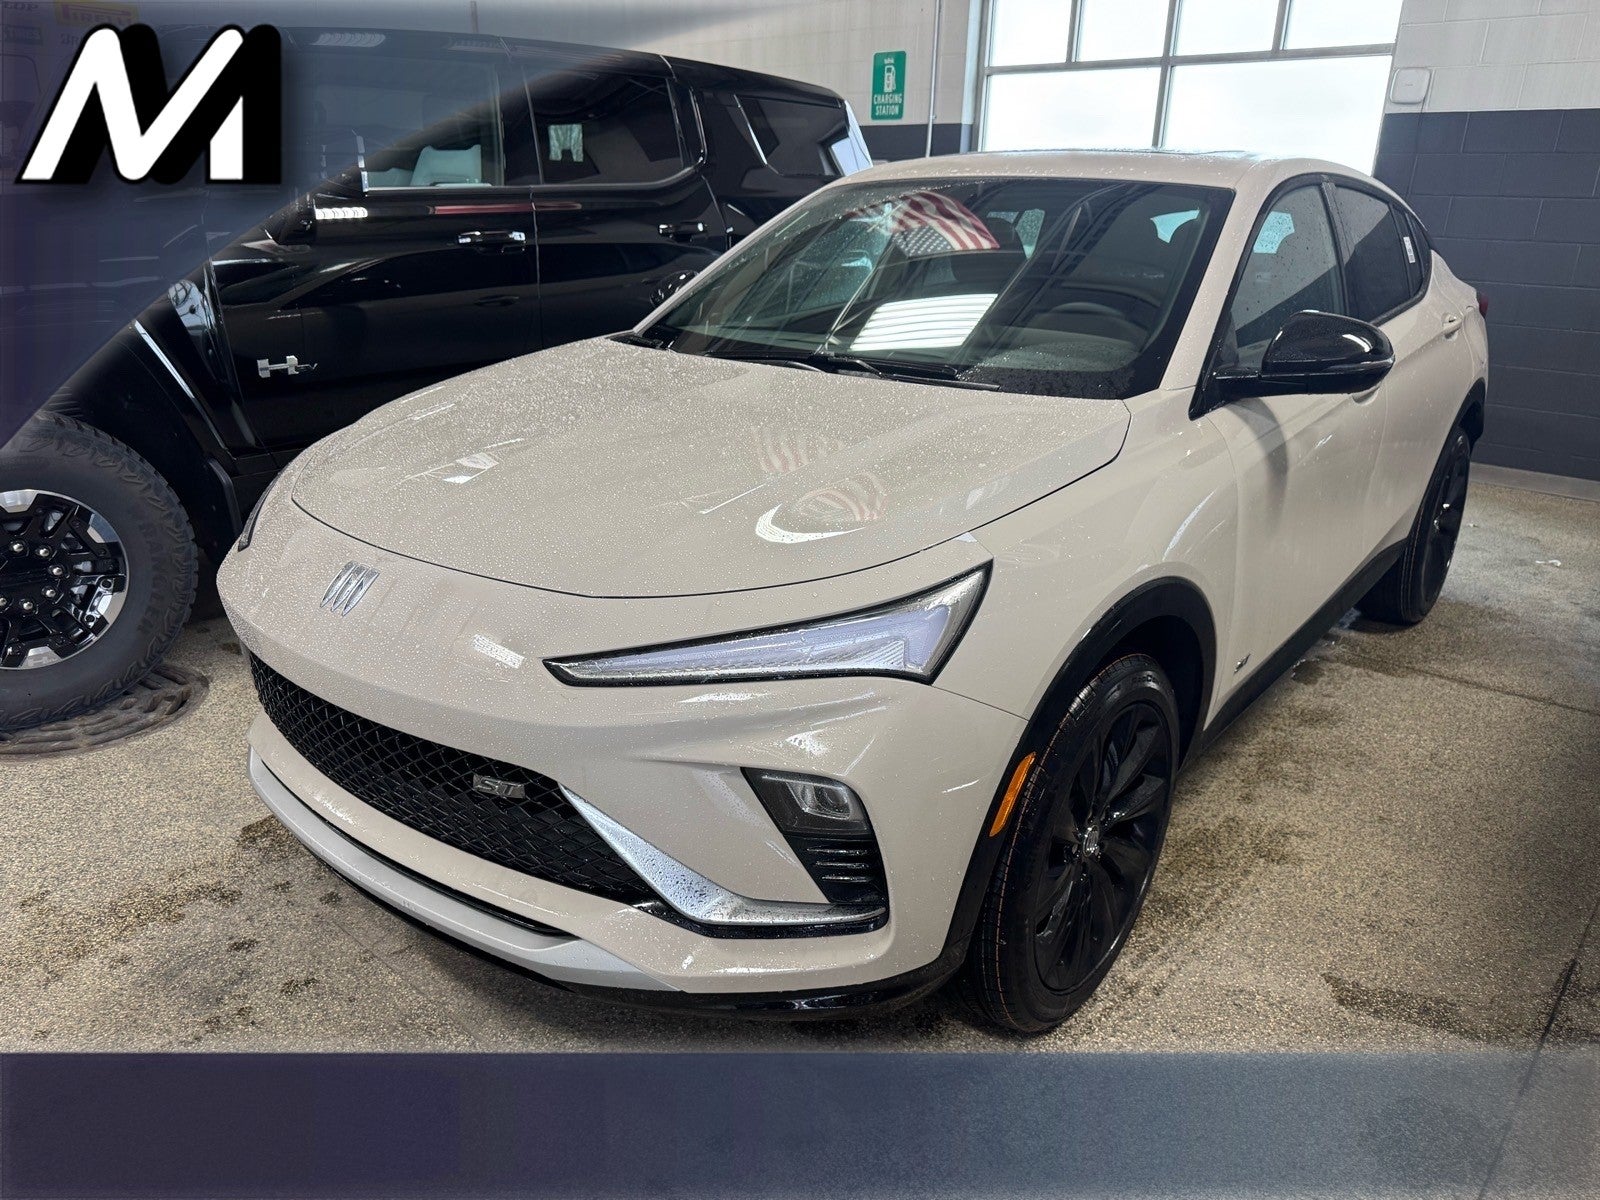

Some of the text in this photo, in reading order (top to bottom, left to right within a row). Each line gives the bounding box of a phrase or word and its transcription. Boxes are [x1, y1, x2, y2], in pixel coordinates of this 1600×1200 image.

[873, 93, 903, 104] CHARGING
[875, 105, 900, 116] STATION
[473, 774, 525, 798] ST
